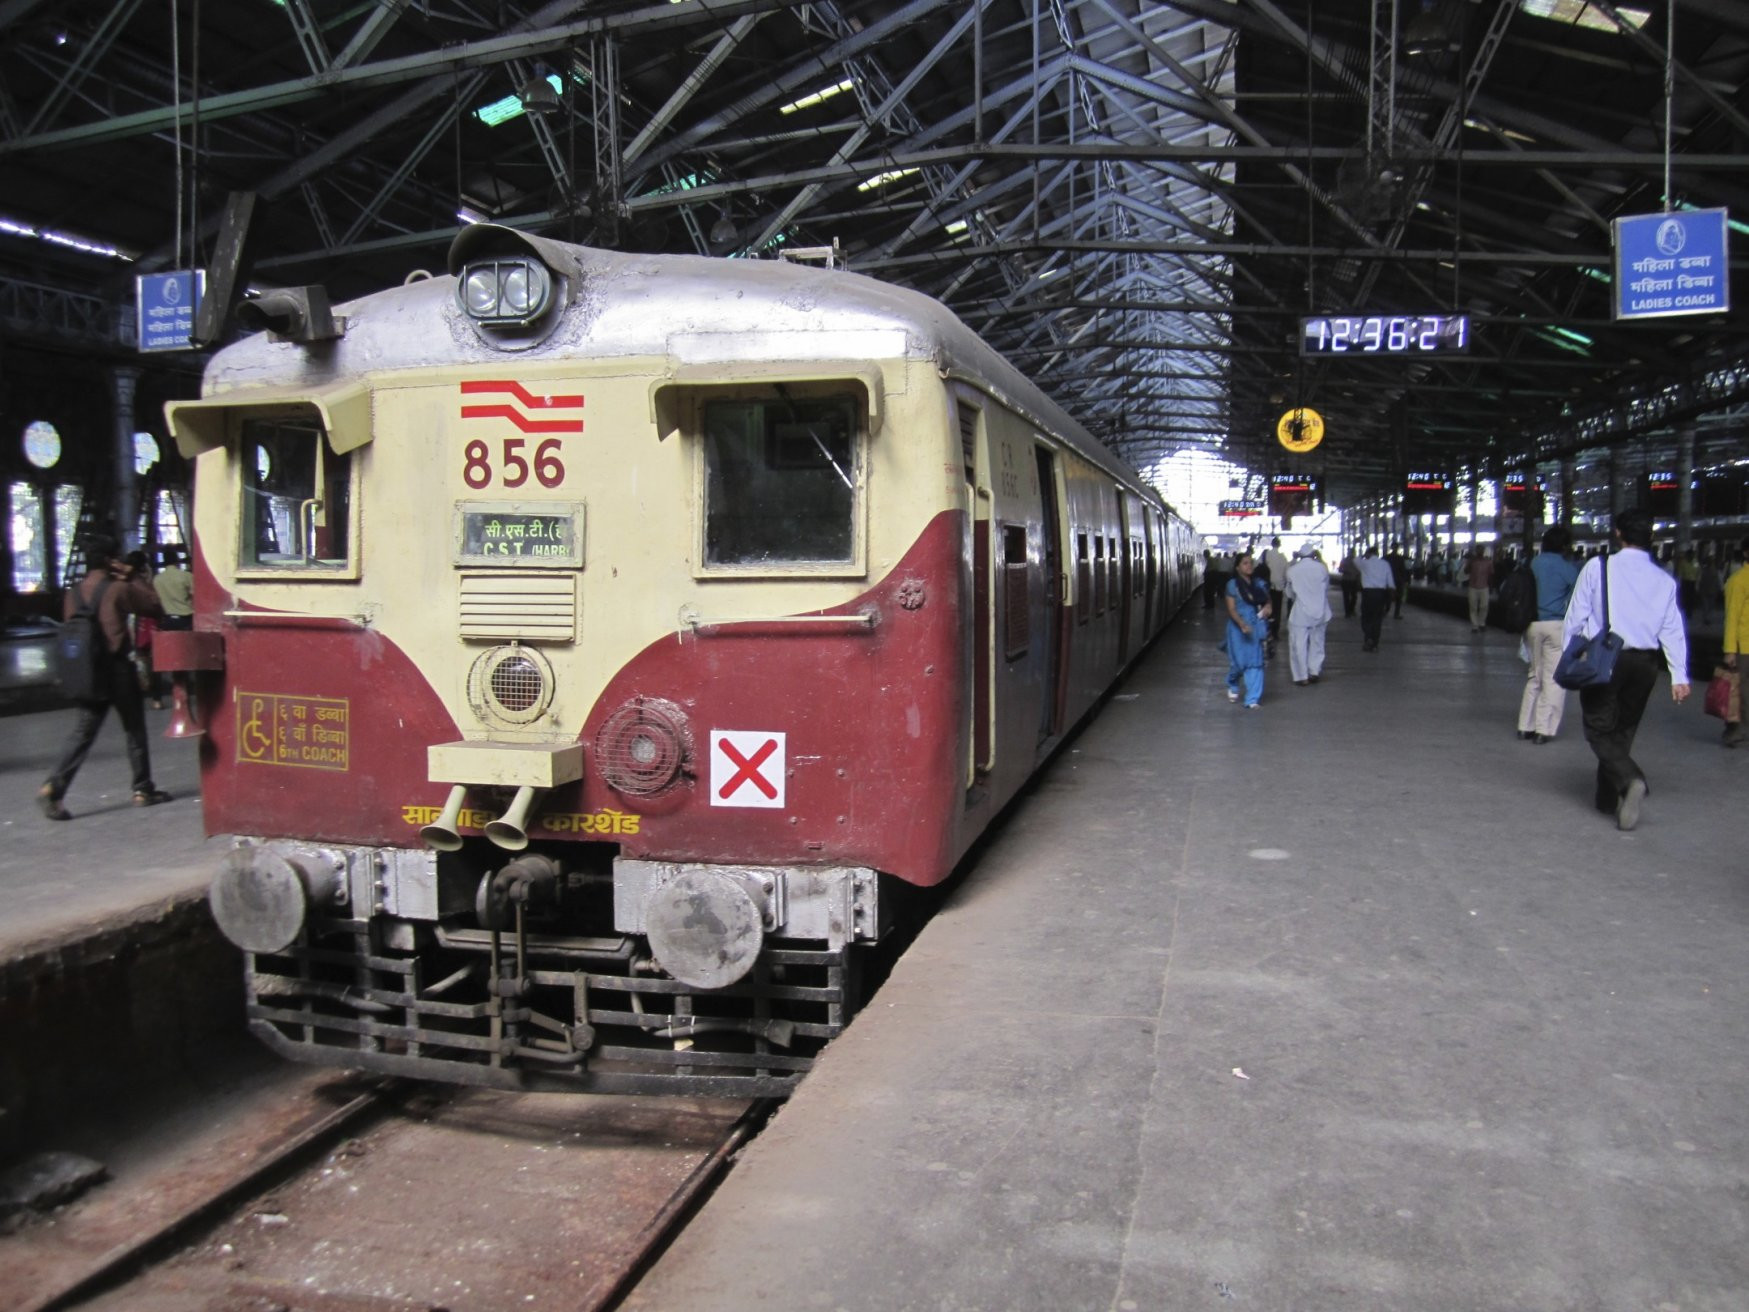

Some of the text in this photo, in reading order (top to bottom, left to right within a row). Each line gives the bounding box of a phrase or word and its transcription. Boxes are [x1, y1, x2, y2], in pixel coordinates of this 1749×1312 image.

[1631, 257, 1676, 273] महिला
[1630, 276, 1673, 293] महिला
[1631, 294, 1715, 311] LADIES COACH
[147, 336, 174, 346] LADIES
[1318, 317, 1466, 352] 12:36:21
[463, 438, 566, 490] 856
[302, 745, 346, 762] COACH
